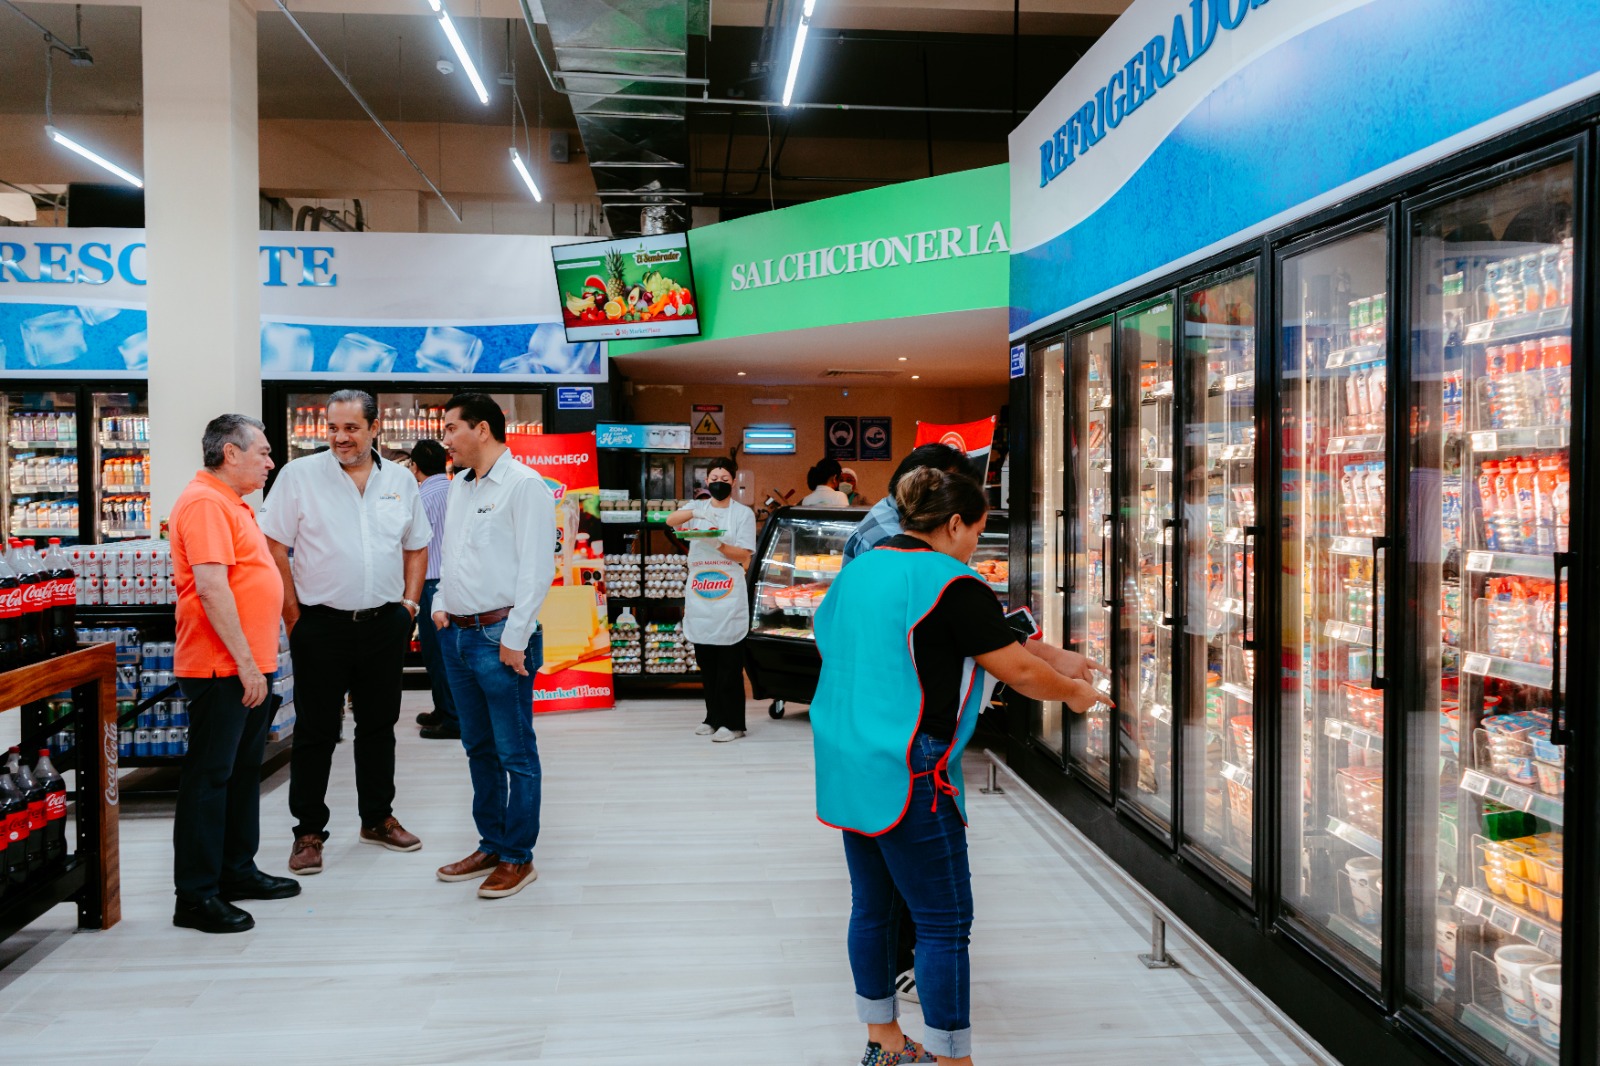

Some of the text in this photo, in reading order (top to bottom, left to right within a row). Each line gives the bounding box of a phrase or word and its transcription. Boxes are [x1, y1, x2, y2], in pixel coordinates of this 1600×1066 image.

[1040, 0, 1270, 188] REFRIGERAD
[730, 221, 1010, 292] SALCHICHONERIA
[526, 453, 589, 465] MANCHEGO
[691, 578, 733, 591] Poland
[532, 685, 611, 701] MarketPlace
